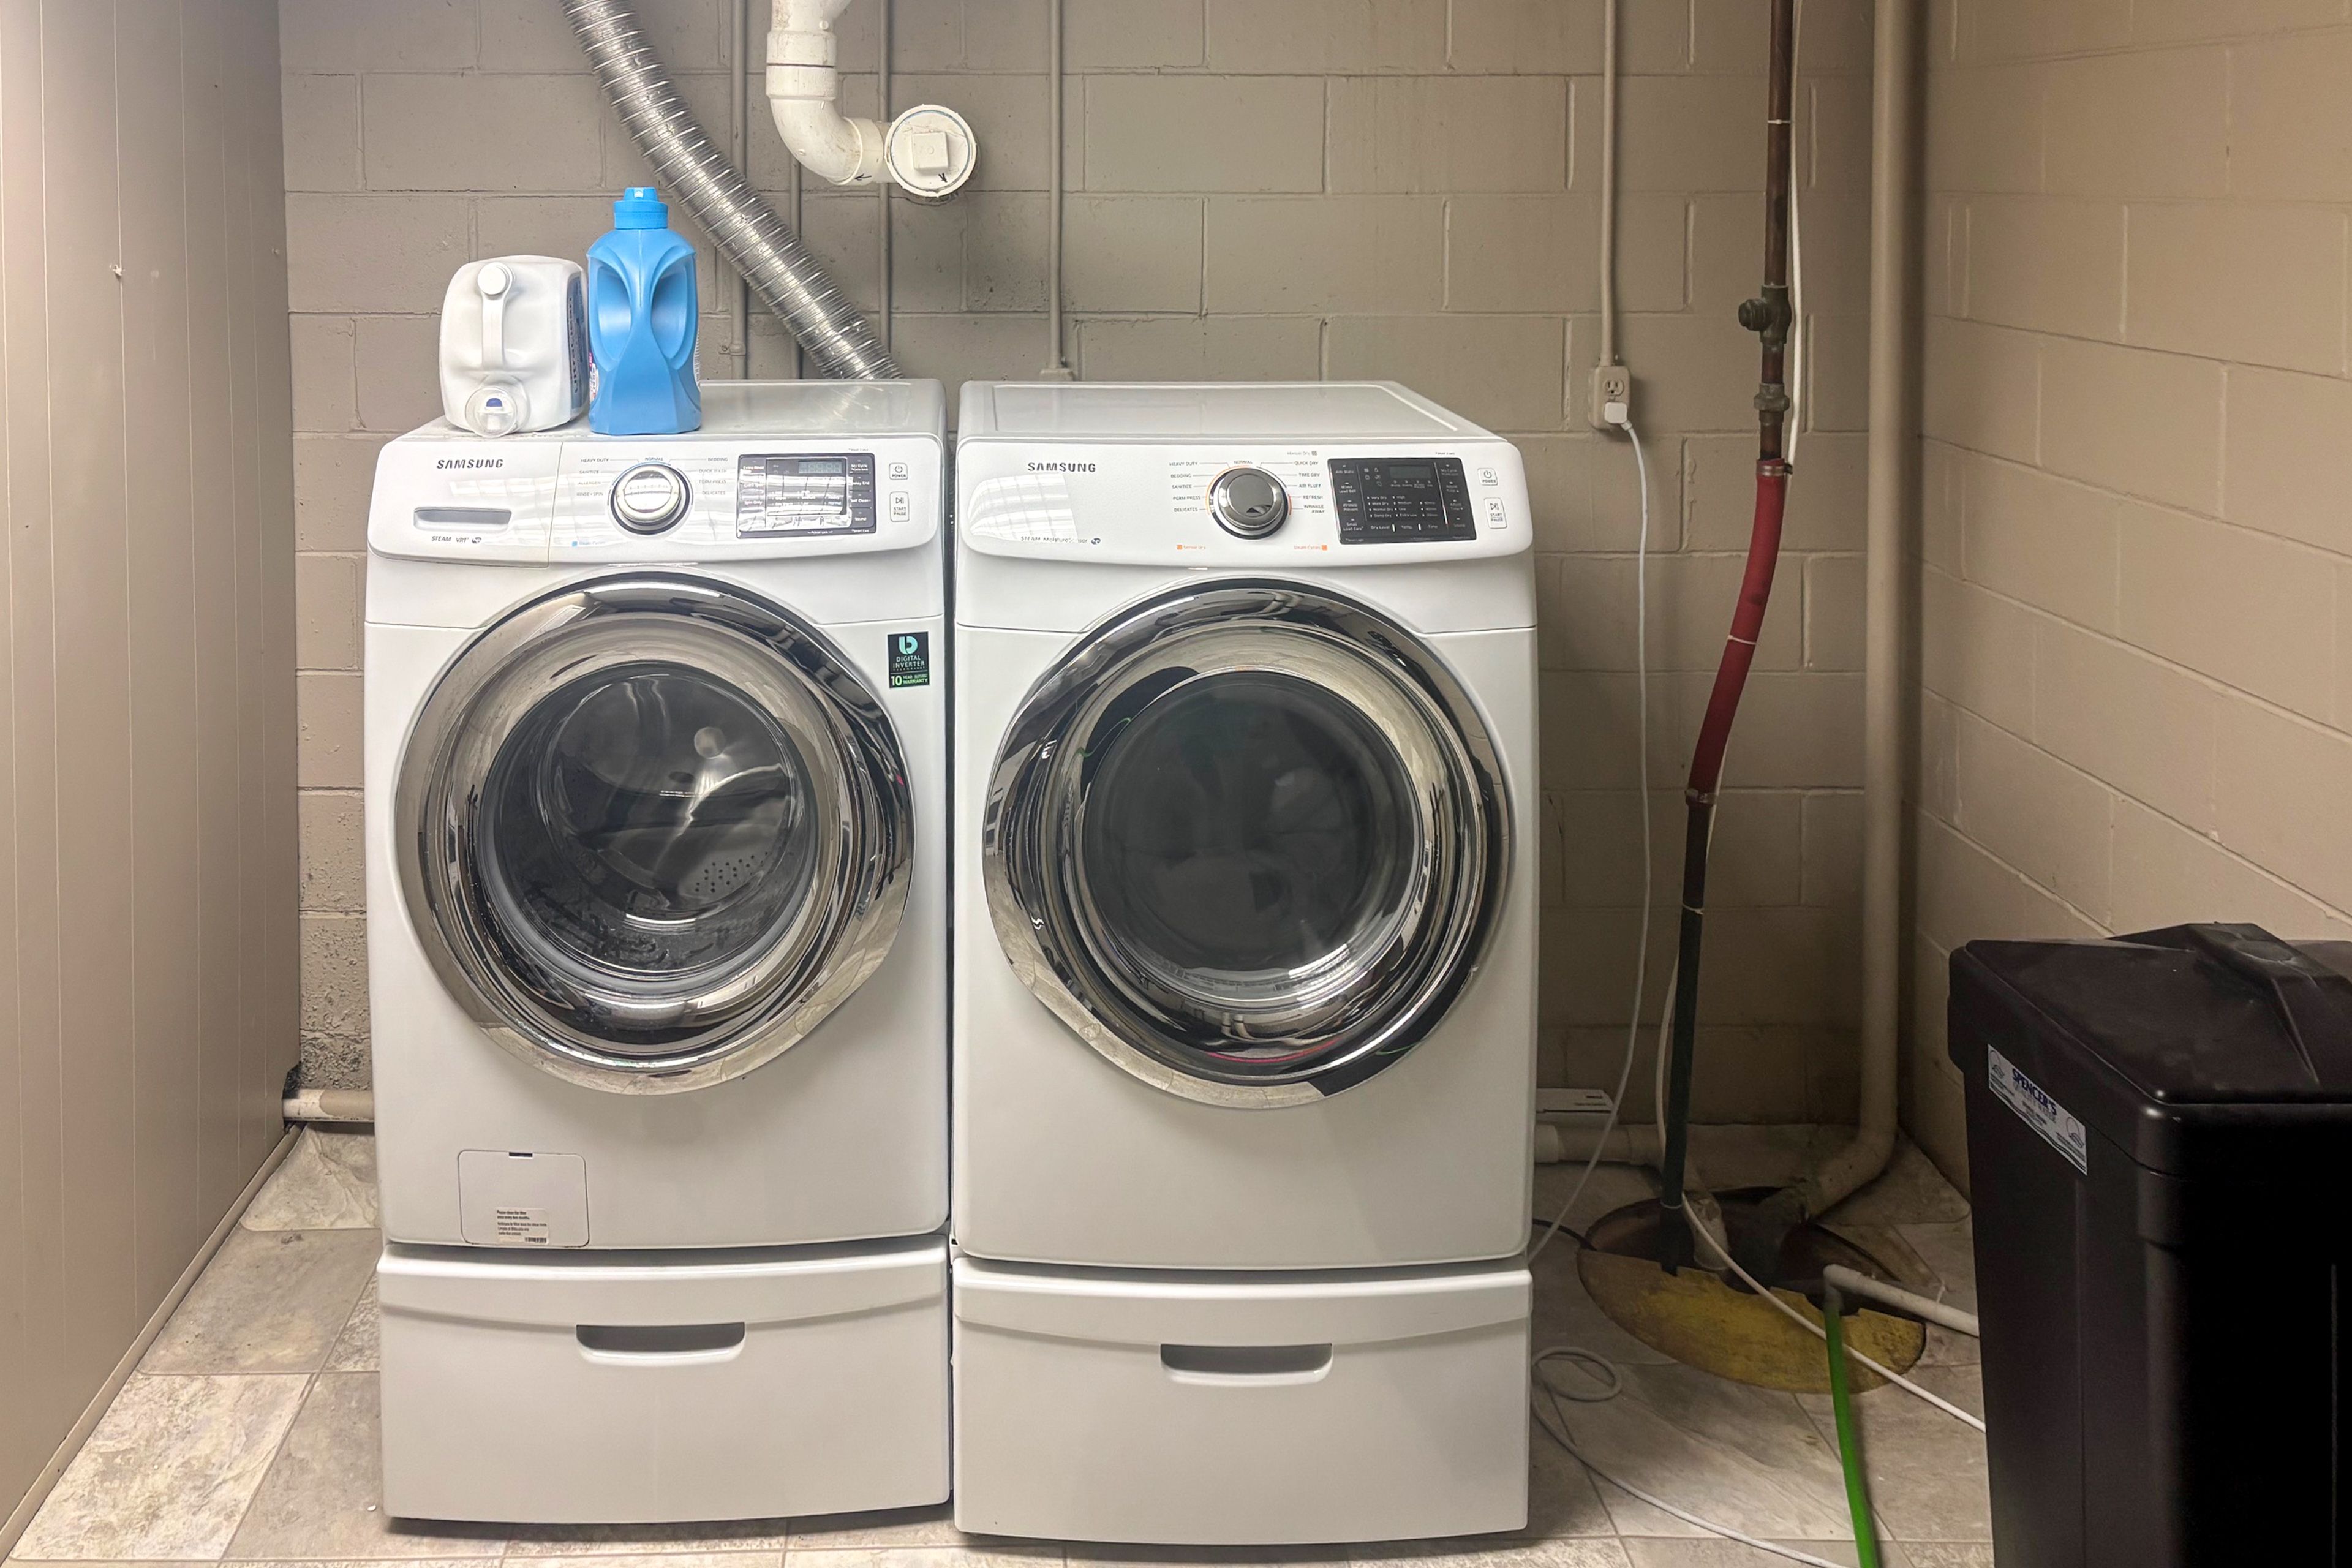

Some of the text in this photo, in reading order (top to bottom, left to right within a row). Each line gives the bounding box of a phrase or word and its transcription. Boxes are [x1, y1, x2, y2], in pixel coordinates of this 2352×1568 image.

[437, 459, 503, 469] SAMSUNG
[1028, 462, 1096, 472] SAMSUNG
[891, 675, 903, 686] 10
[2012, 1068, 2057, 1115] SPENCER'S
